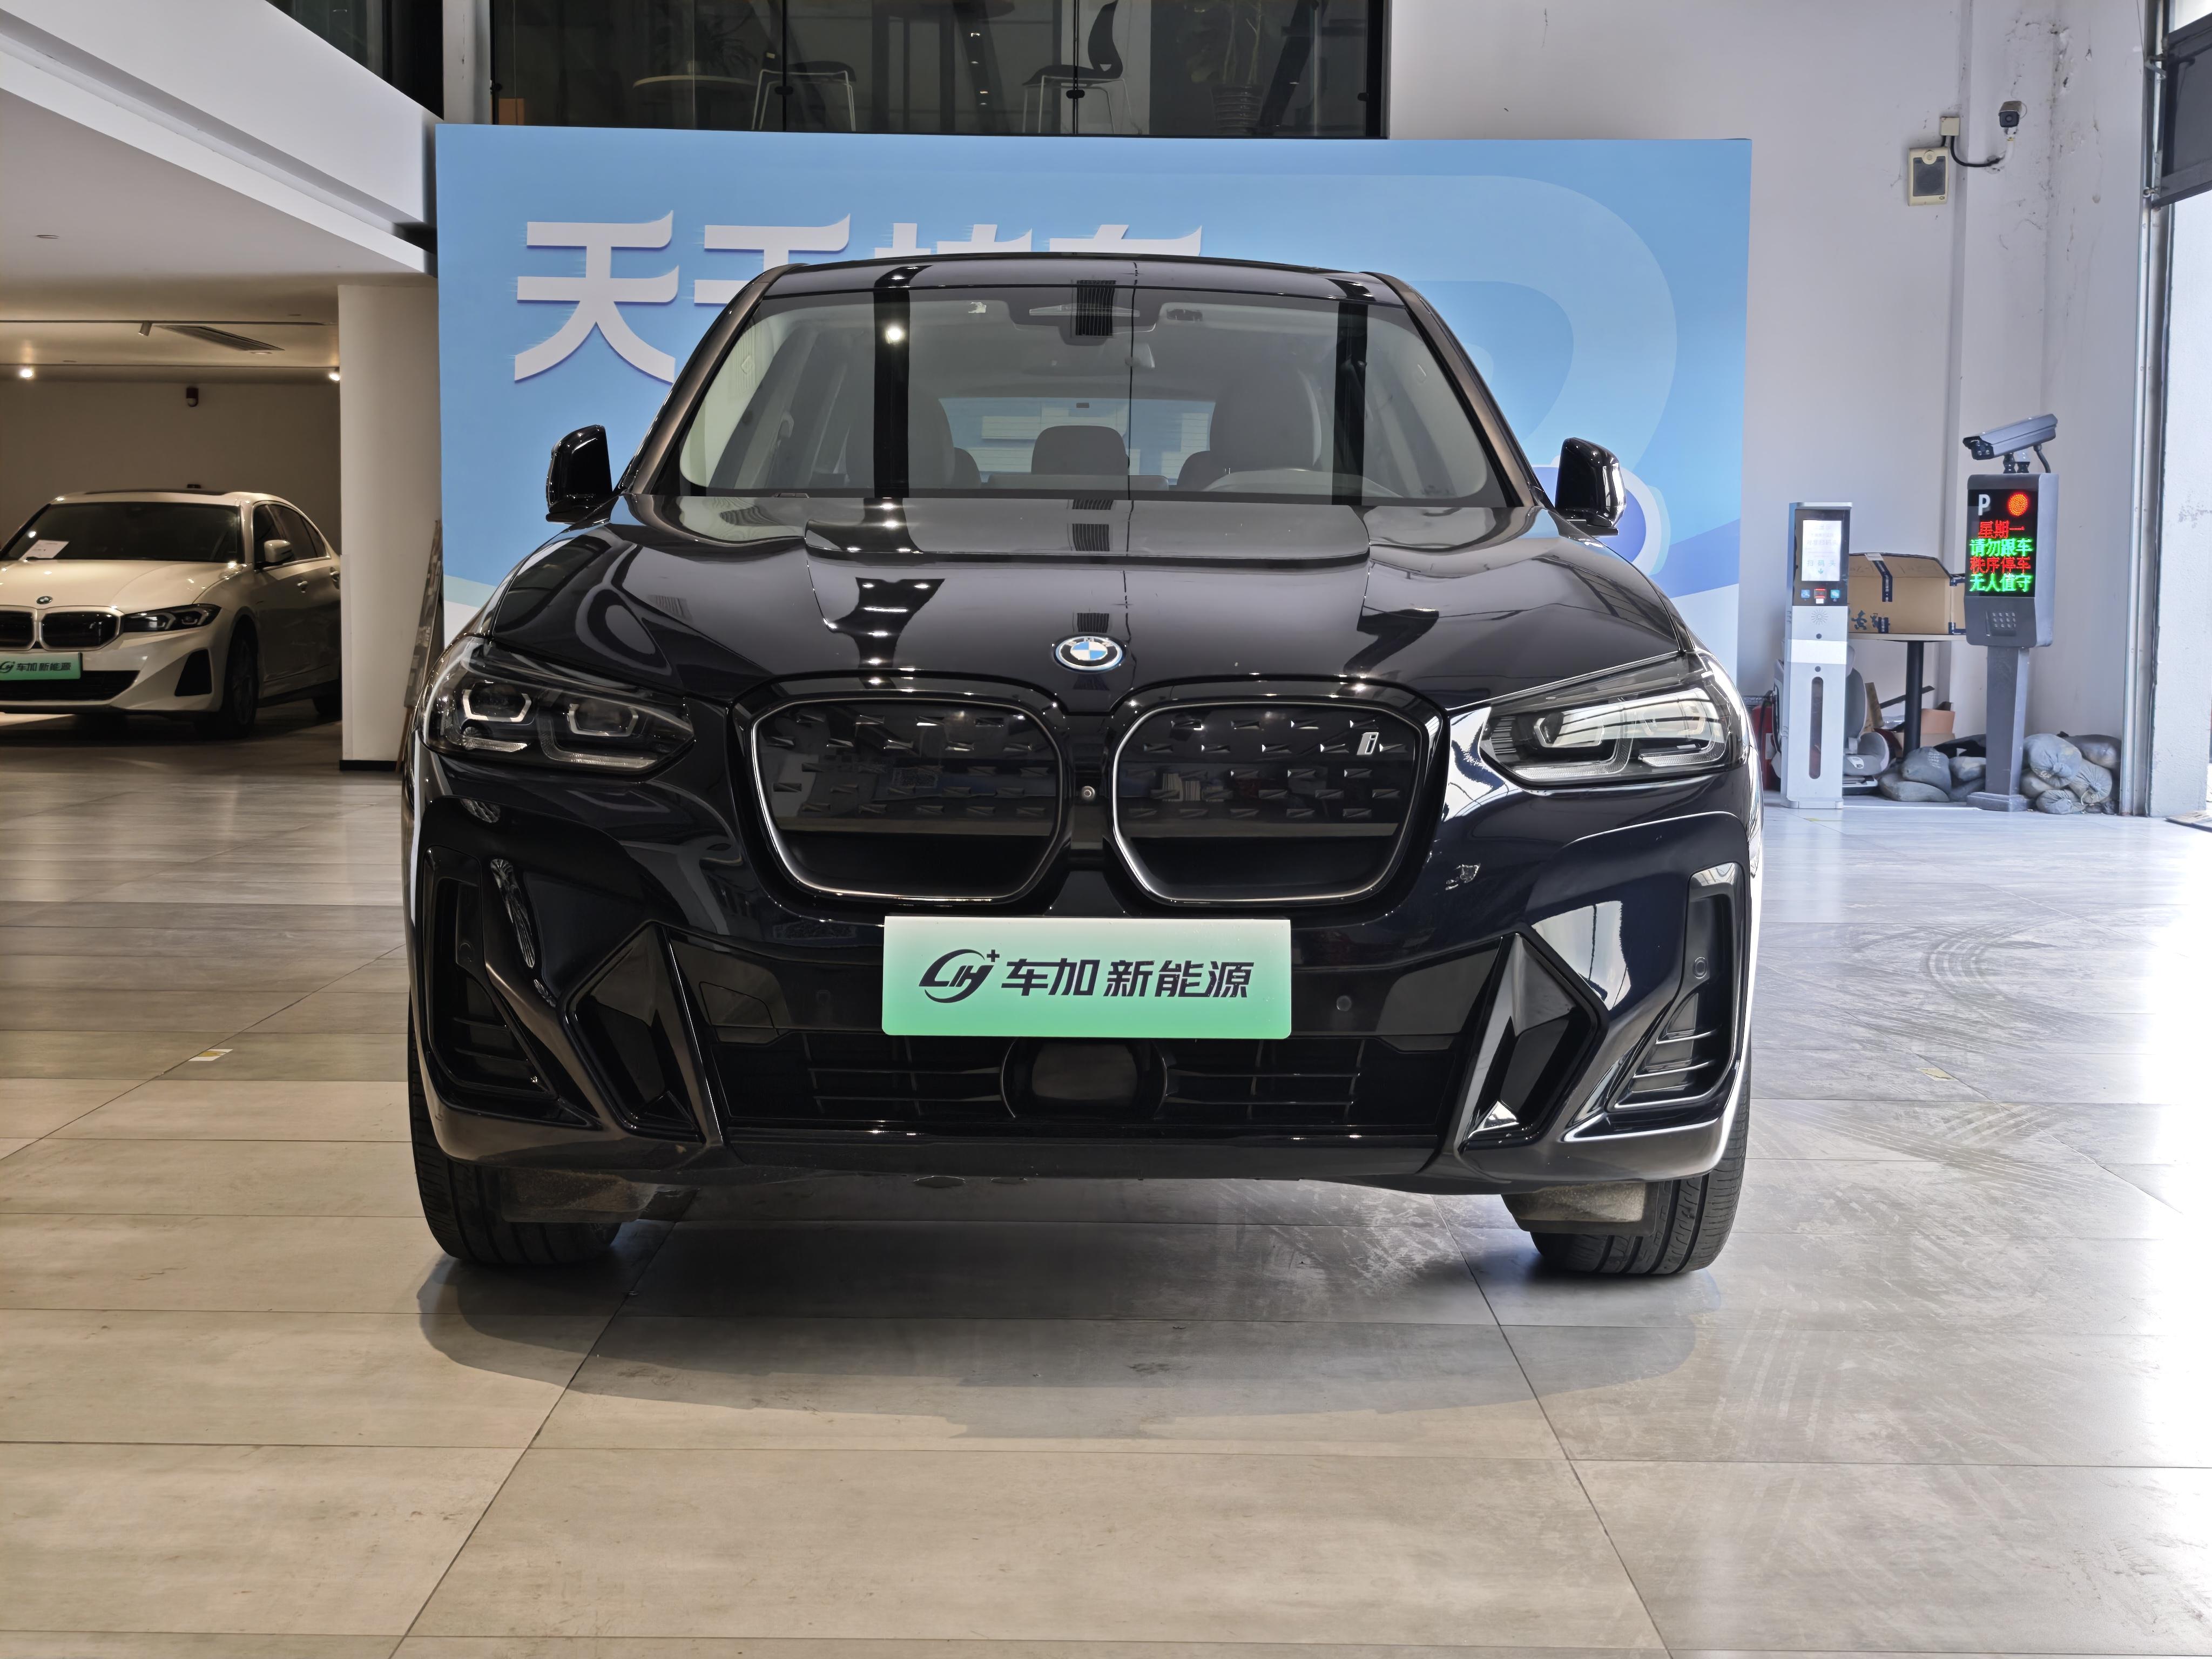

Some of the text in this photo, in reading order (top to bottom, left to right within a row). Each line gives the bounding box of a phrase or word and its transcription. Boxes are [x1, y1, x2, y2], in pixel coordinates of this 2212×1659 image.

[1978, 494, 1991, 516] P
[1978, 520, 2025, 538] 星期一
[1970, 538, 2033, 557] 请勿跟车
[1970, 556, 2031, 574] 秩序停车
[1969, 573, 2033, 592] 无人值守
